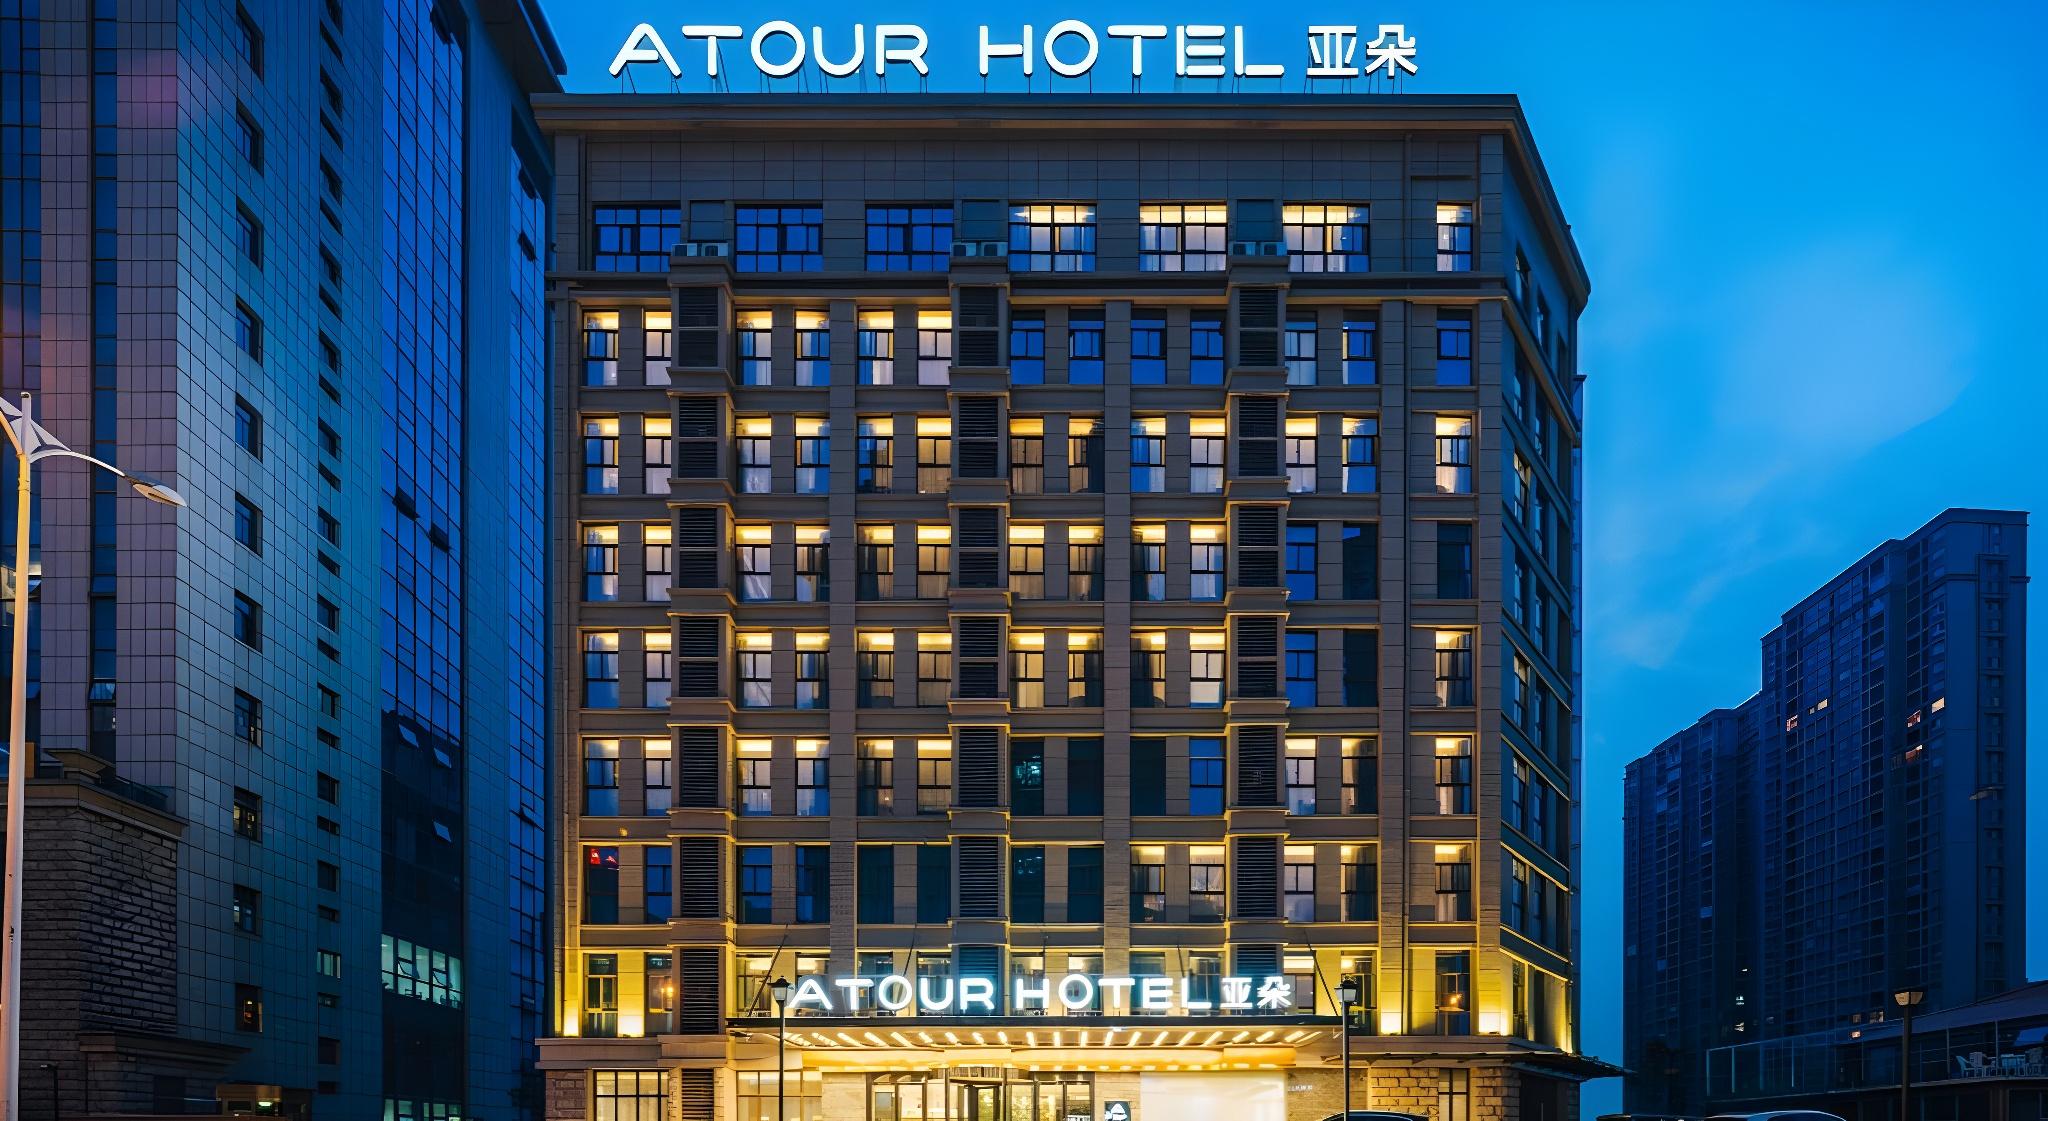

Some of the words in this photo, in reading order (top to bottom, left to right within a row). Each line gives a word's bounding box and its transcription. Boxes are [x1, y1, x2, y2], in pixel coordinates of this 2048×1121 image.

[608, 20, 929, 77] ATOUR
[979, 19, 1285, 76] HOTEL
[1307, 24, 1418, 77] 亚朵
[788, 974, 995, 1011] ATOUR
[1015, 973, 1213, 1011] HOTEL
[1220, 976, 1292, 1010] 亚朵
